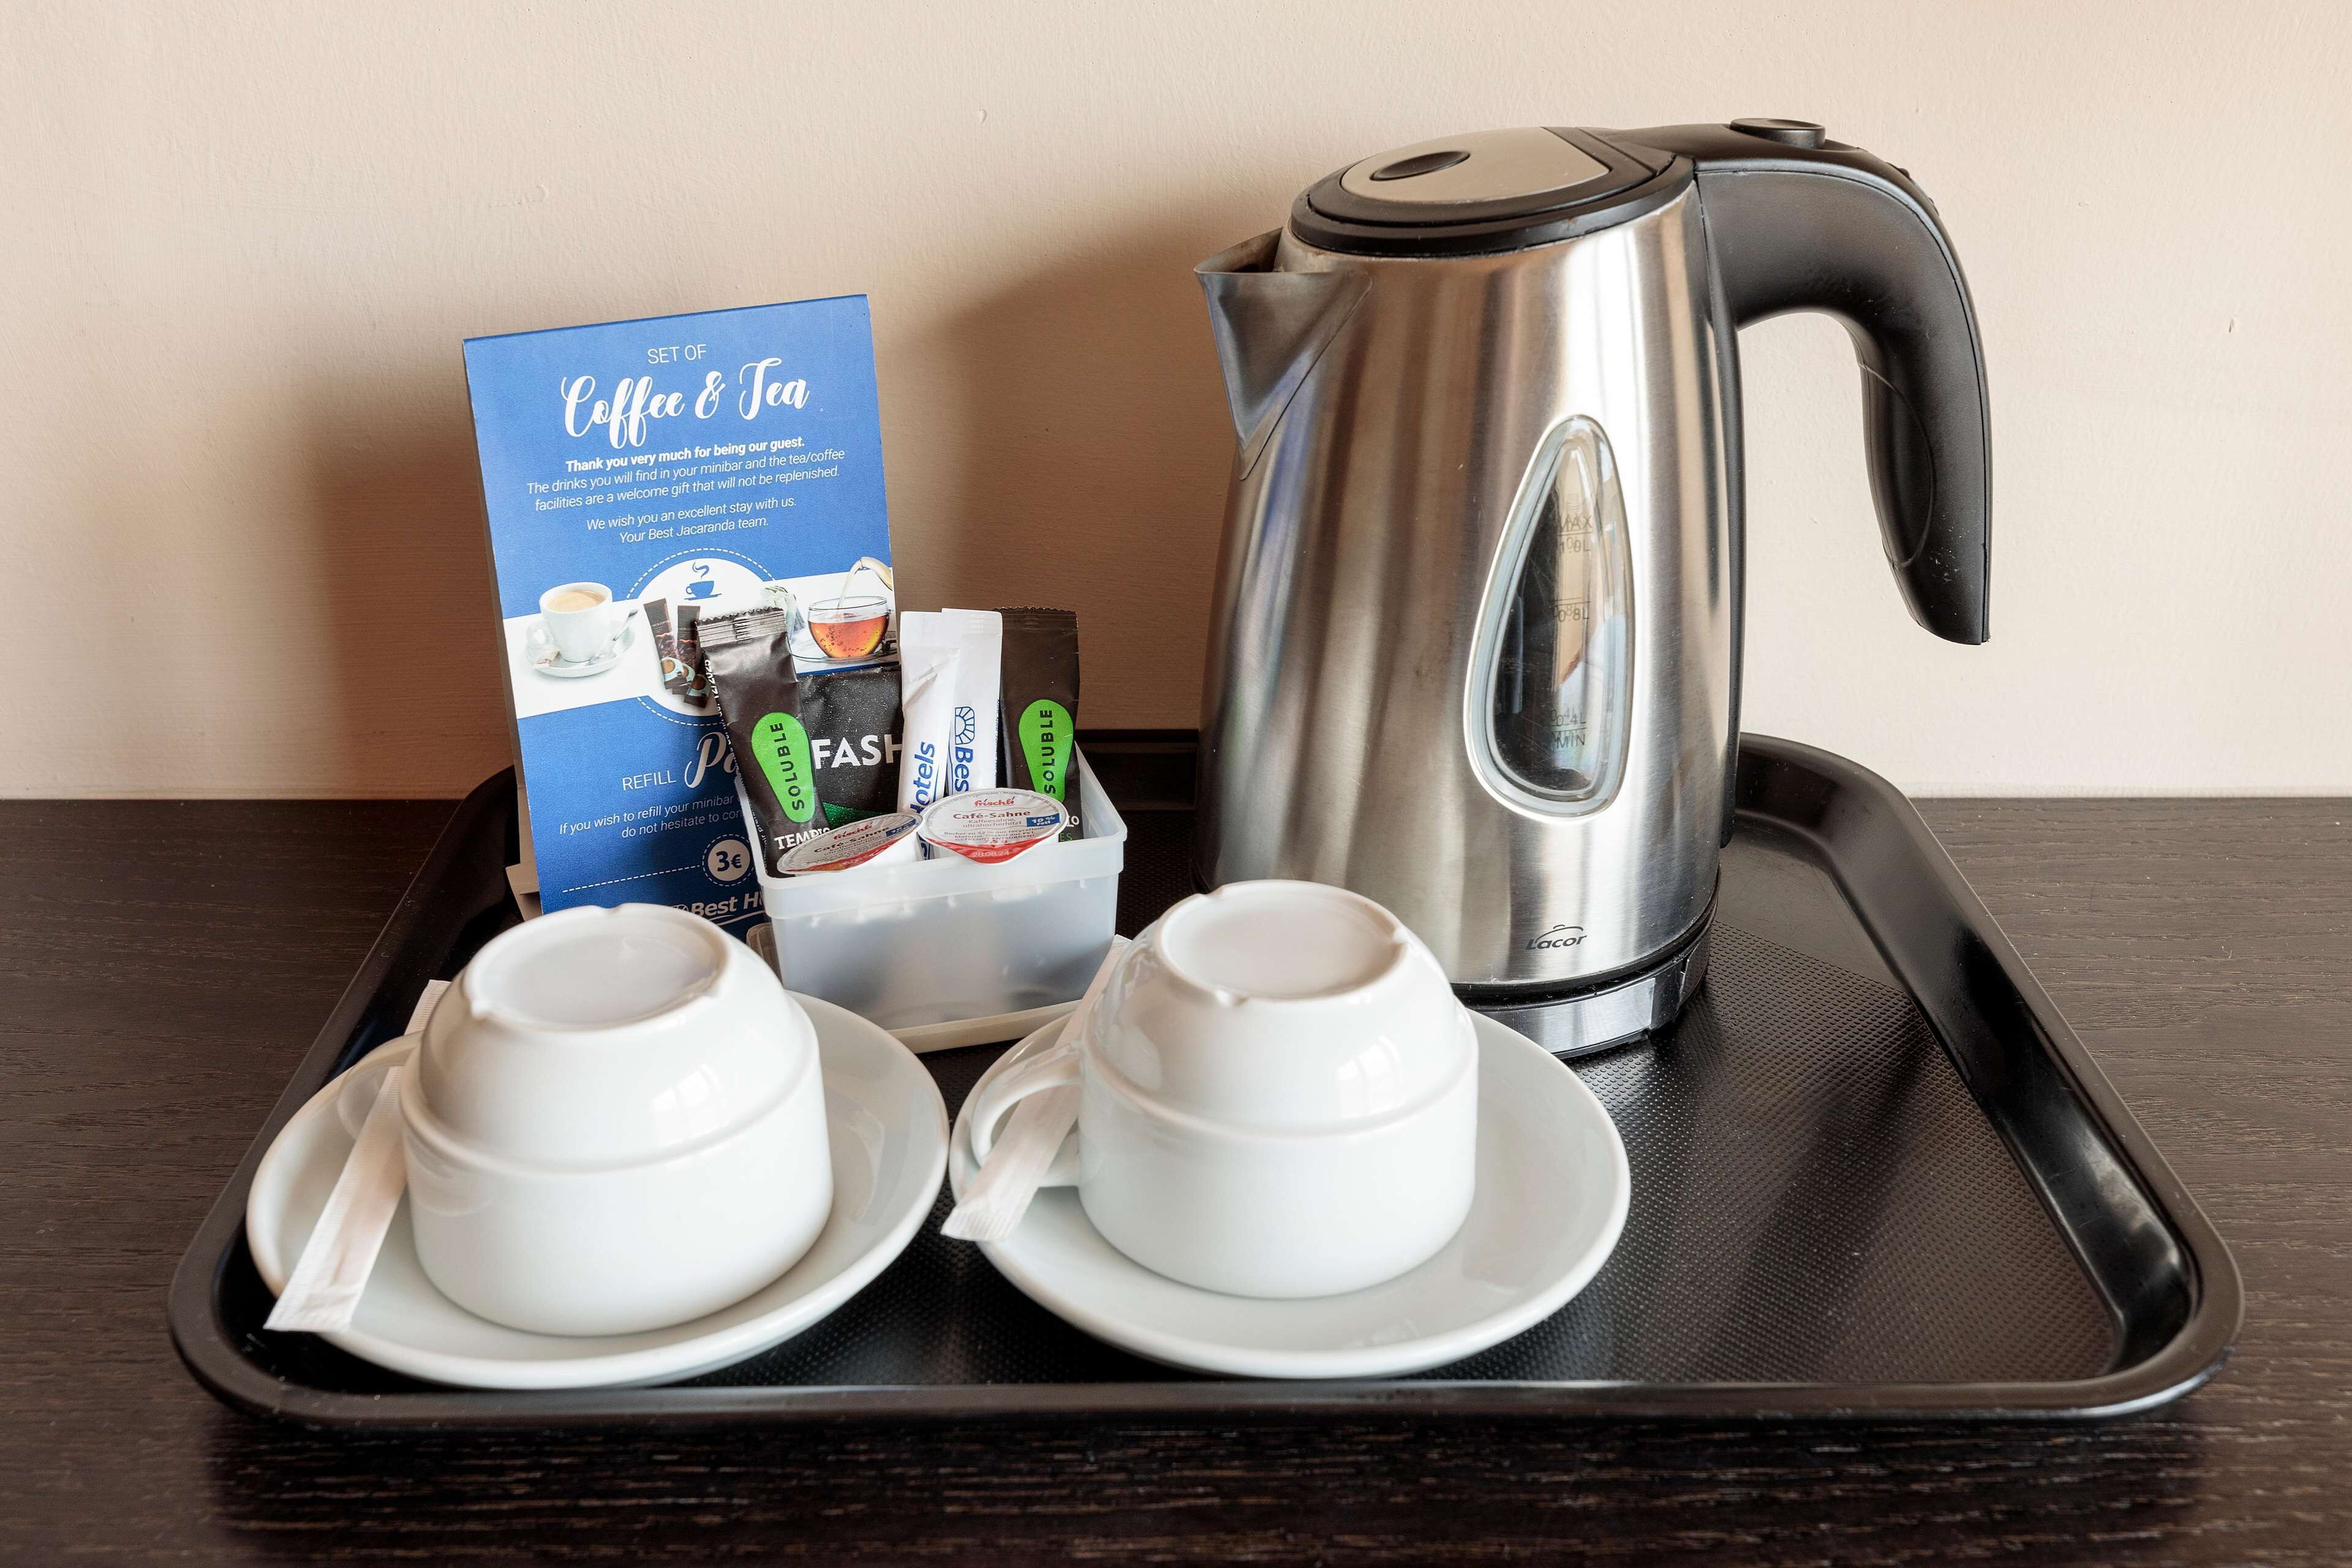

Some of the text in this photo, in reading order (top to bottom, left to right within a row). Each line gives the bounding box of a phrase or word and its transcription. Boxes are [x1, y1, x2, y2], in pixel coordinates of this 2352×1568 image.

[647, 344, 706, 364] SET OF
[560, 357, 810, 449] Coffee & Tea
[566, 436, 805, 472] Thank you very much for being our guest.
[527, 448, 845, 494] The drinks you will find in your minibar and the tea/coffee
[535, 465, 840, 511] facilities are a welcome gift that will not be replenished.
[586, 497, 796, 530] We wish you an excellent stay with us.
[619, 516, 769, 544] Your Best Jacaranda team.
[811, 734, 903, 769] FASH
[1039, 710, 1056, 794] SOLUBLE
[1556, 734, 1586, 748] MIN
[622, 770, 677, 791] REFILL
[769, 723, 805, 810] SOLUBLE
[559, 824, 568, 835] If
[570, 820, 591, 835] you
[594, 814, 620, 828] wish
[623, 812, 635, 822] to
[638, 805, 662, 819] refill
[665, 802, 690, 818] your
[692, 794, 735, 810] minibar
[622, 827, 636, 838] do
[639, 821, 658, 834] not
[660, 814, 705, 831] hesitate
[708, 812, 720, 823] to
[715, 851, 742, 872] 3€
[691, 896, 738, 917] Best
[1525, 935, 1588, 950] Lacor
